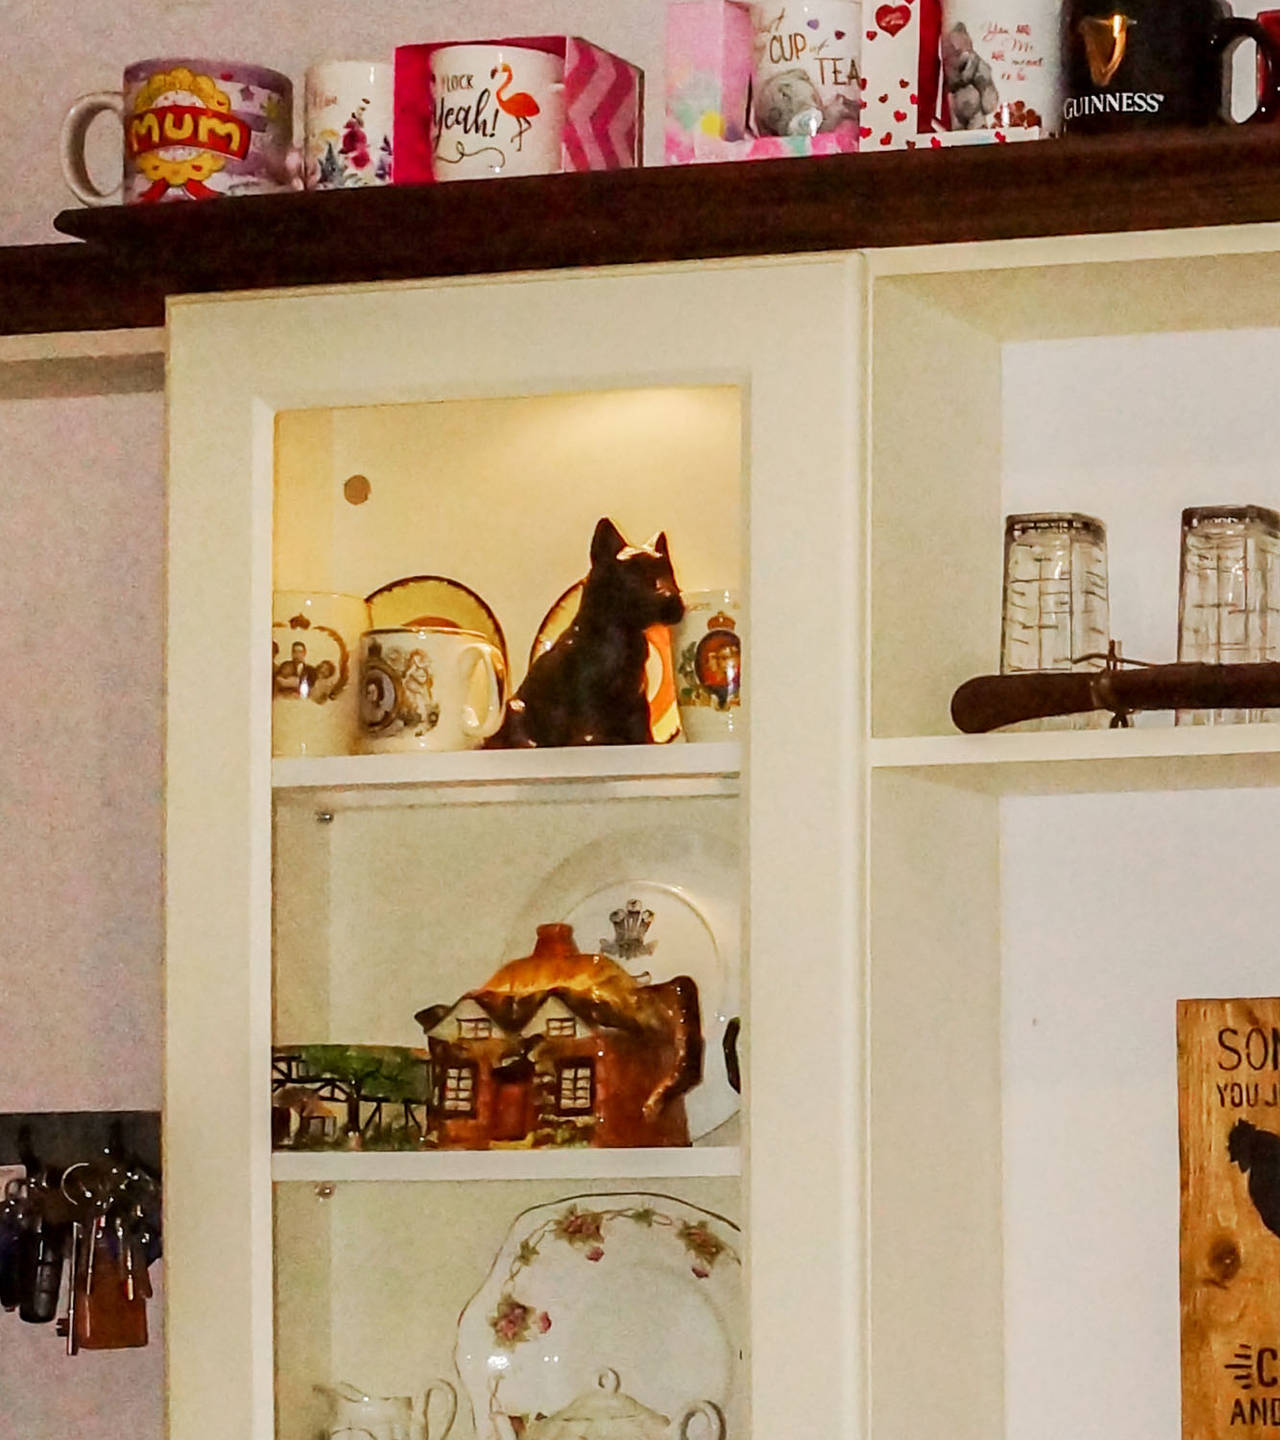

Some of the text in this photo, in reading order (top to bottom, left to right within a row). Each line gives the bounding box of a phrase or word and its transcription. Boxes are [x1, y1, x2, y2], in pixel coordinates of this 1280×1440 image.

[769, 32, 807, 64] CUP
[814, 57, 862, 92] TEA
[1063, 92, 1162, 120] GUINNESS
[132, 112, 241, 152] MUM
[1216, 1082, 1259, 1108] YOU
